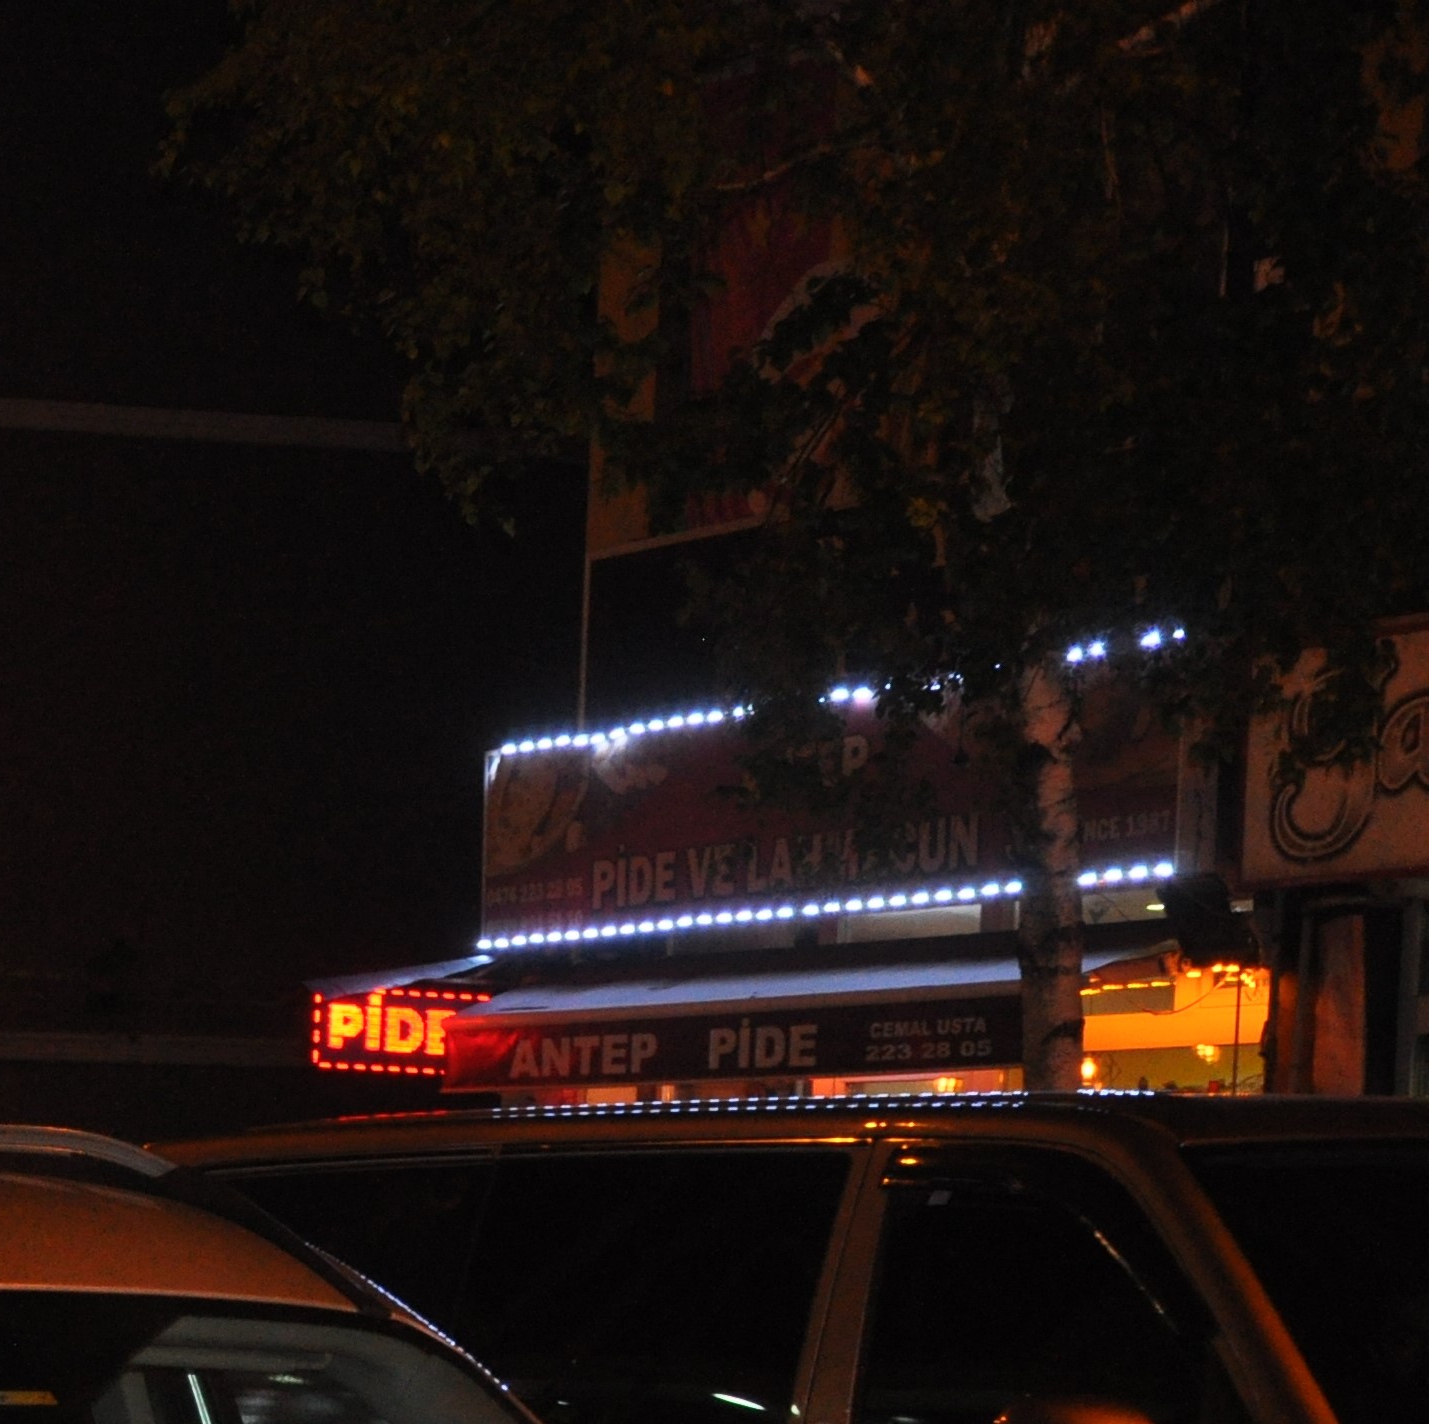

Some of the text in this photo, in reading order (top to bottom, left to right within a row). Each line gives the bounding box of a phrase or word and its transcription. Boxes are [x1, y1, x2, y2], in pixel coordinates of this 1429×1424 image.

[591, 843, 677, 909] PİDE
[686, 841, 736, 899] VE
[327, 991, 456, 1056] PİDE
[508, 1018, 818, 1079] ANTEP PİDE
[865, 1038, 992, 1061] 223 28 05
[869, 1016, 988, 1039] CEMAL USTA
